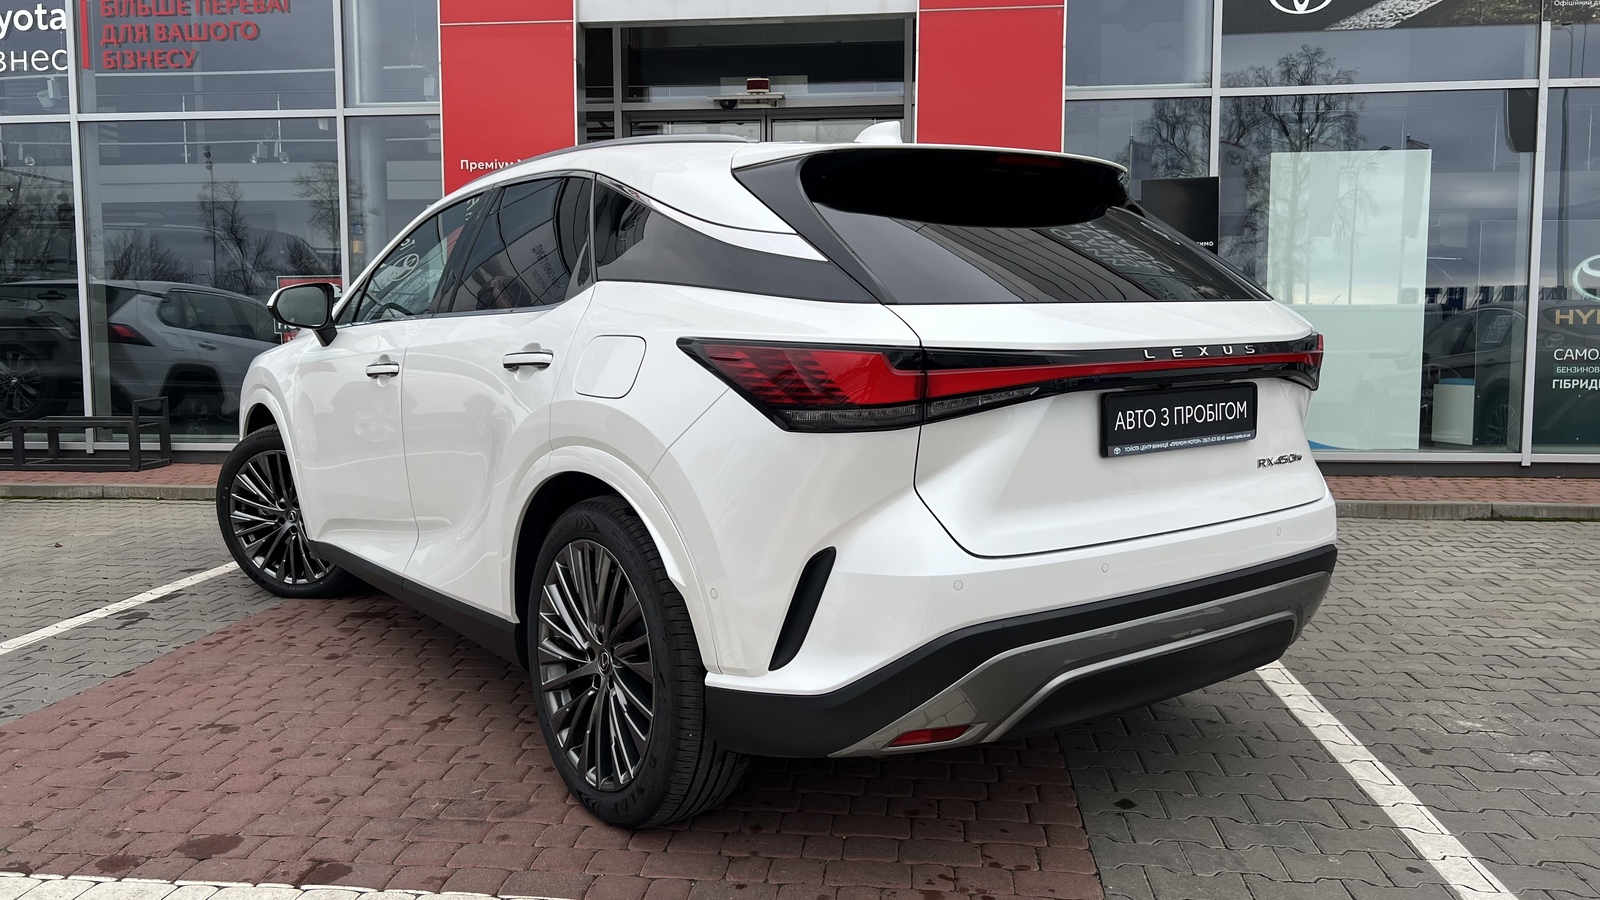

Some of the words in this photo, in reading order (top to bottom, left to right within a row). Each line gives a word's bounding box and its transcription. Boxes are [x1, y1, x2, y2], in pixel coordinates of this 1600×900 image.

[100, 0, 190, 17] БІЛЬШЕ
[101, 23, 148, 46] ДЛЯ
[154, 21, 259, 42] ВАШОГО
[103, 49, 196, 69] БІЗНЕСУ
[1555, 309, 1600, 325] HY
[1144, 345, 1255, 359] LEXUS
[1553, 348, 1600, 361] САМО
[1556, 366, 1600, 374] БЕНЗИНОВ
[1552, 379, 1600, 390] ГІБРИД
[1114, 408, 1156, 431] АВТО
[1160, 407, 1170, 427] З
[1174, 400, 1247, 425] ПРОБІГОМ
[1257, 457, 1273, 468] RX
